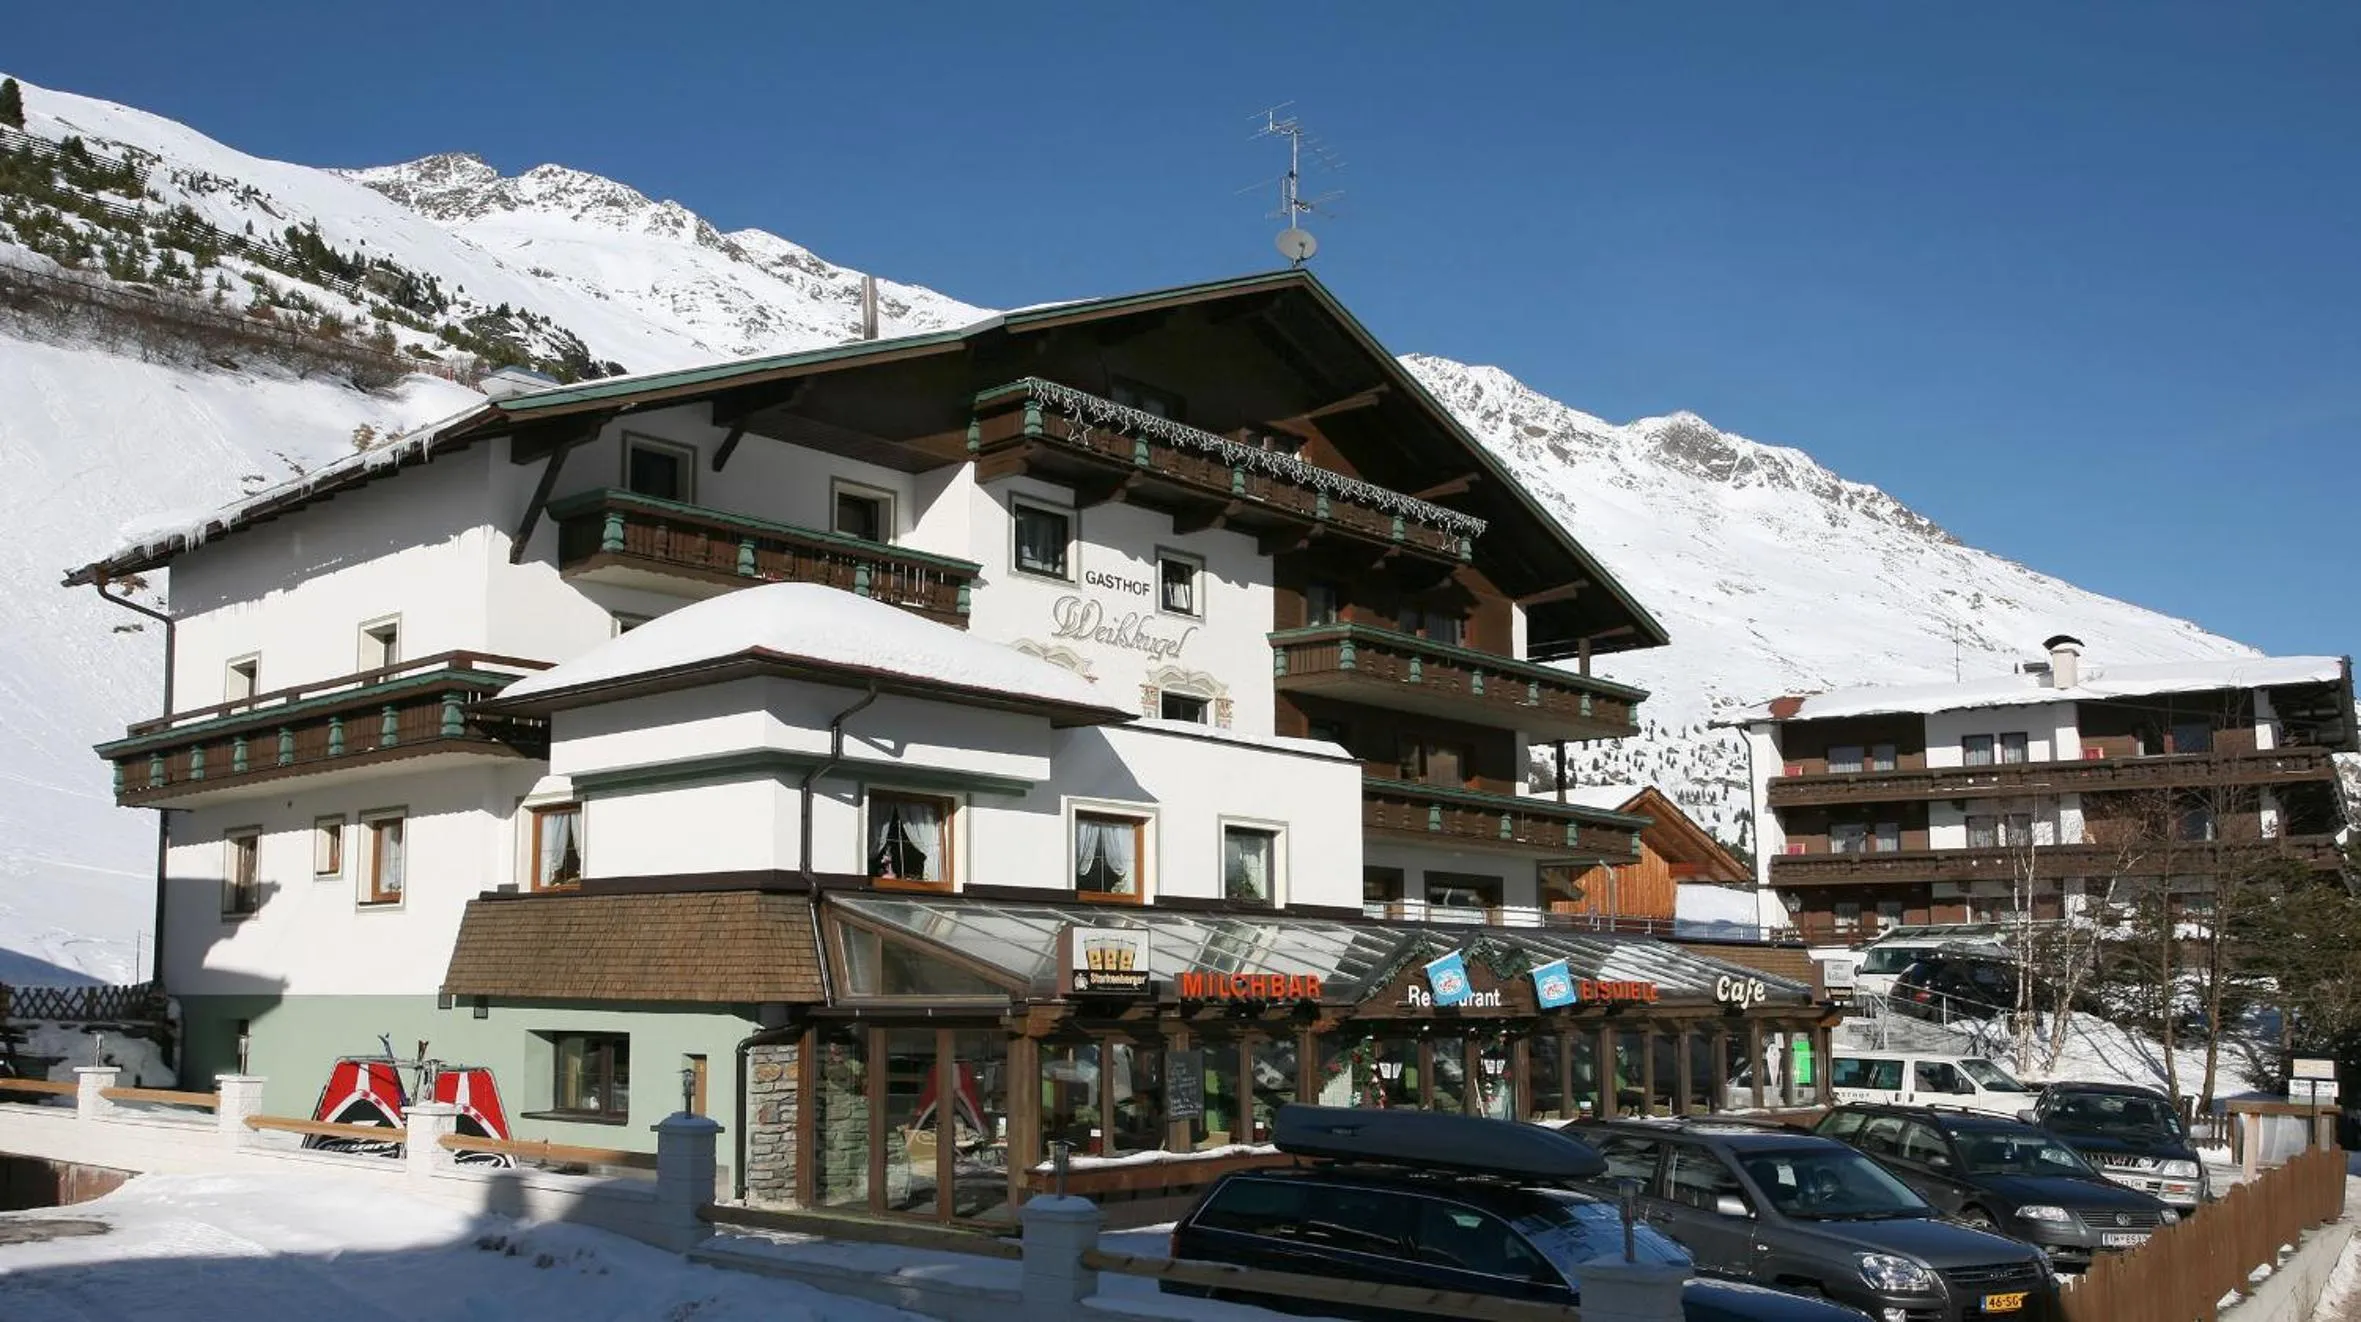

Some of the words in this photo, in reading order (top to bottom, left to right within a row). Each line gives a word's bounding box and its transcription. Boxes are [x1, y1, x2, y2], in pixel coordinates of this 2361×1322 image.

[1085, 570, 1150, 596] GASTHOF
[1183, 970, 1321, 999] MILCHBAR
[1408, 984, 1502, 1007] Reurant
[1716, 975, 1766, 1010] Cafe
